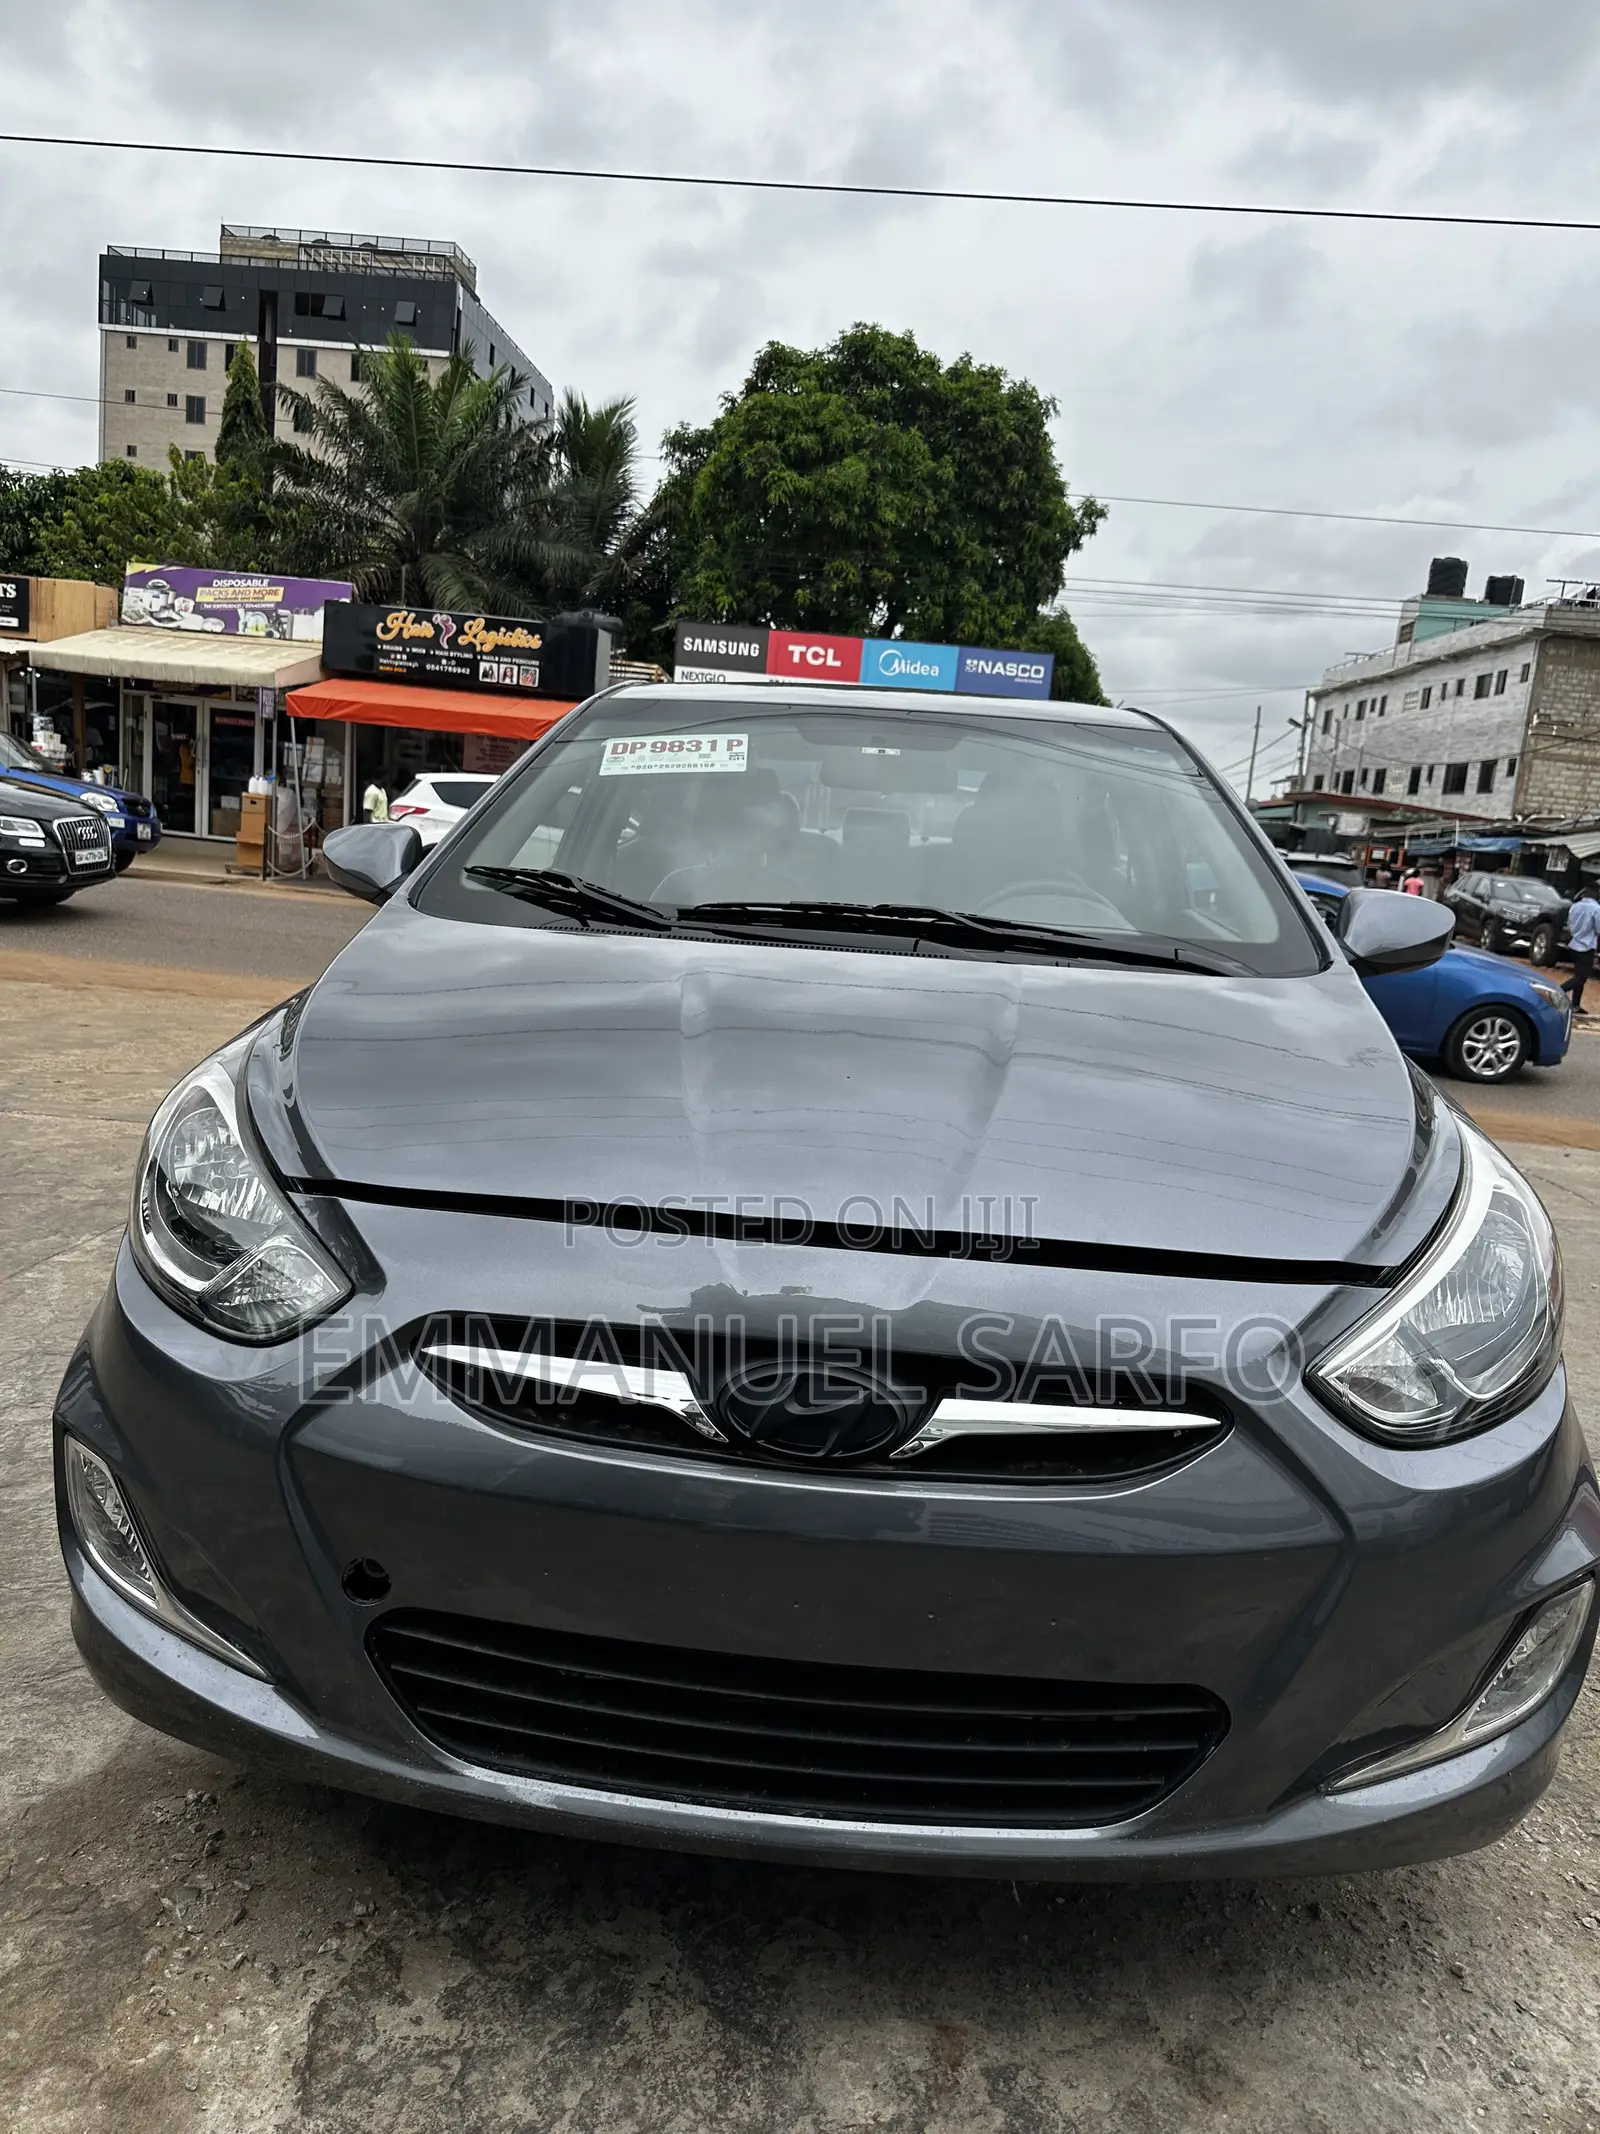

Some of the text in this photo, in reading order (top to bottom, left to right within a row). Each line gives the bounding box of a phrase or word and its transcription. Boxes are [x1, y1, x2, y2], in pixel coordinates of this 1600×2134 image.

[212, 579, 269, 587] DISPOSABLE
[199, 588, 280, 597] PACKS AND MORE
[376, 610, 543, 653] Hair Logistics
[449, 651, 474, 660] STYLING
[683, 637, 760, 658] SAMSUNG
[787, 644, 842, 668] TCL
[500, 656, 512, 664] AND
[512, 657, 540, 667] PEDICURE
[881, 652, 940, 677] Midea
[977, 660, 1045, 679] NASCO
[610, 738, 744, 756] DP 9831 P
